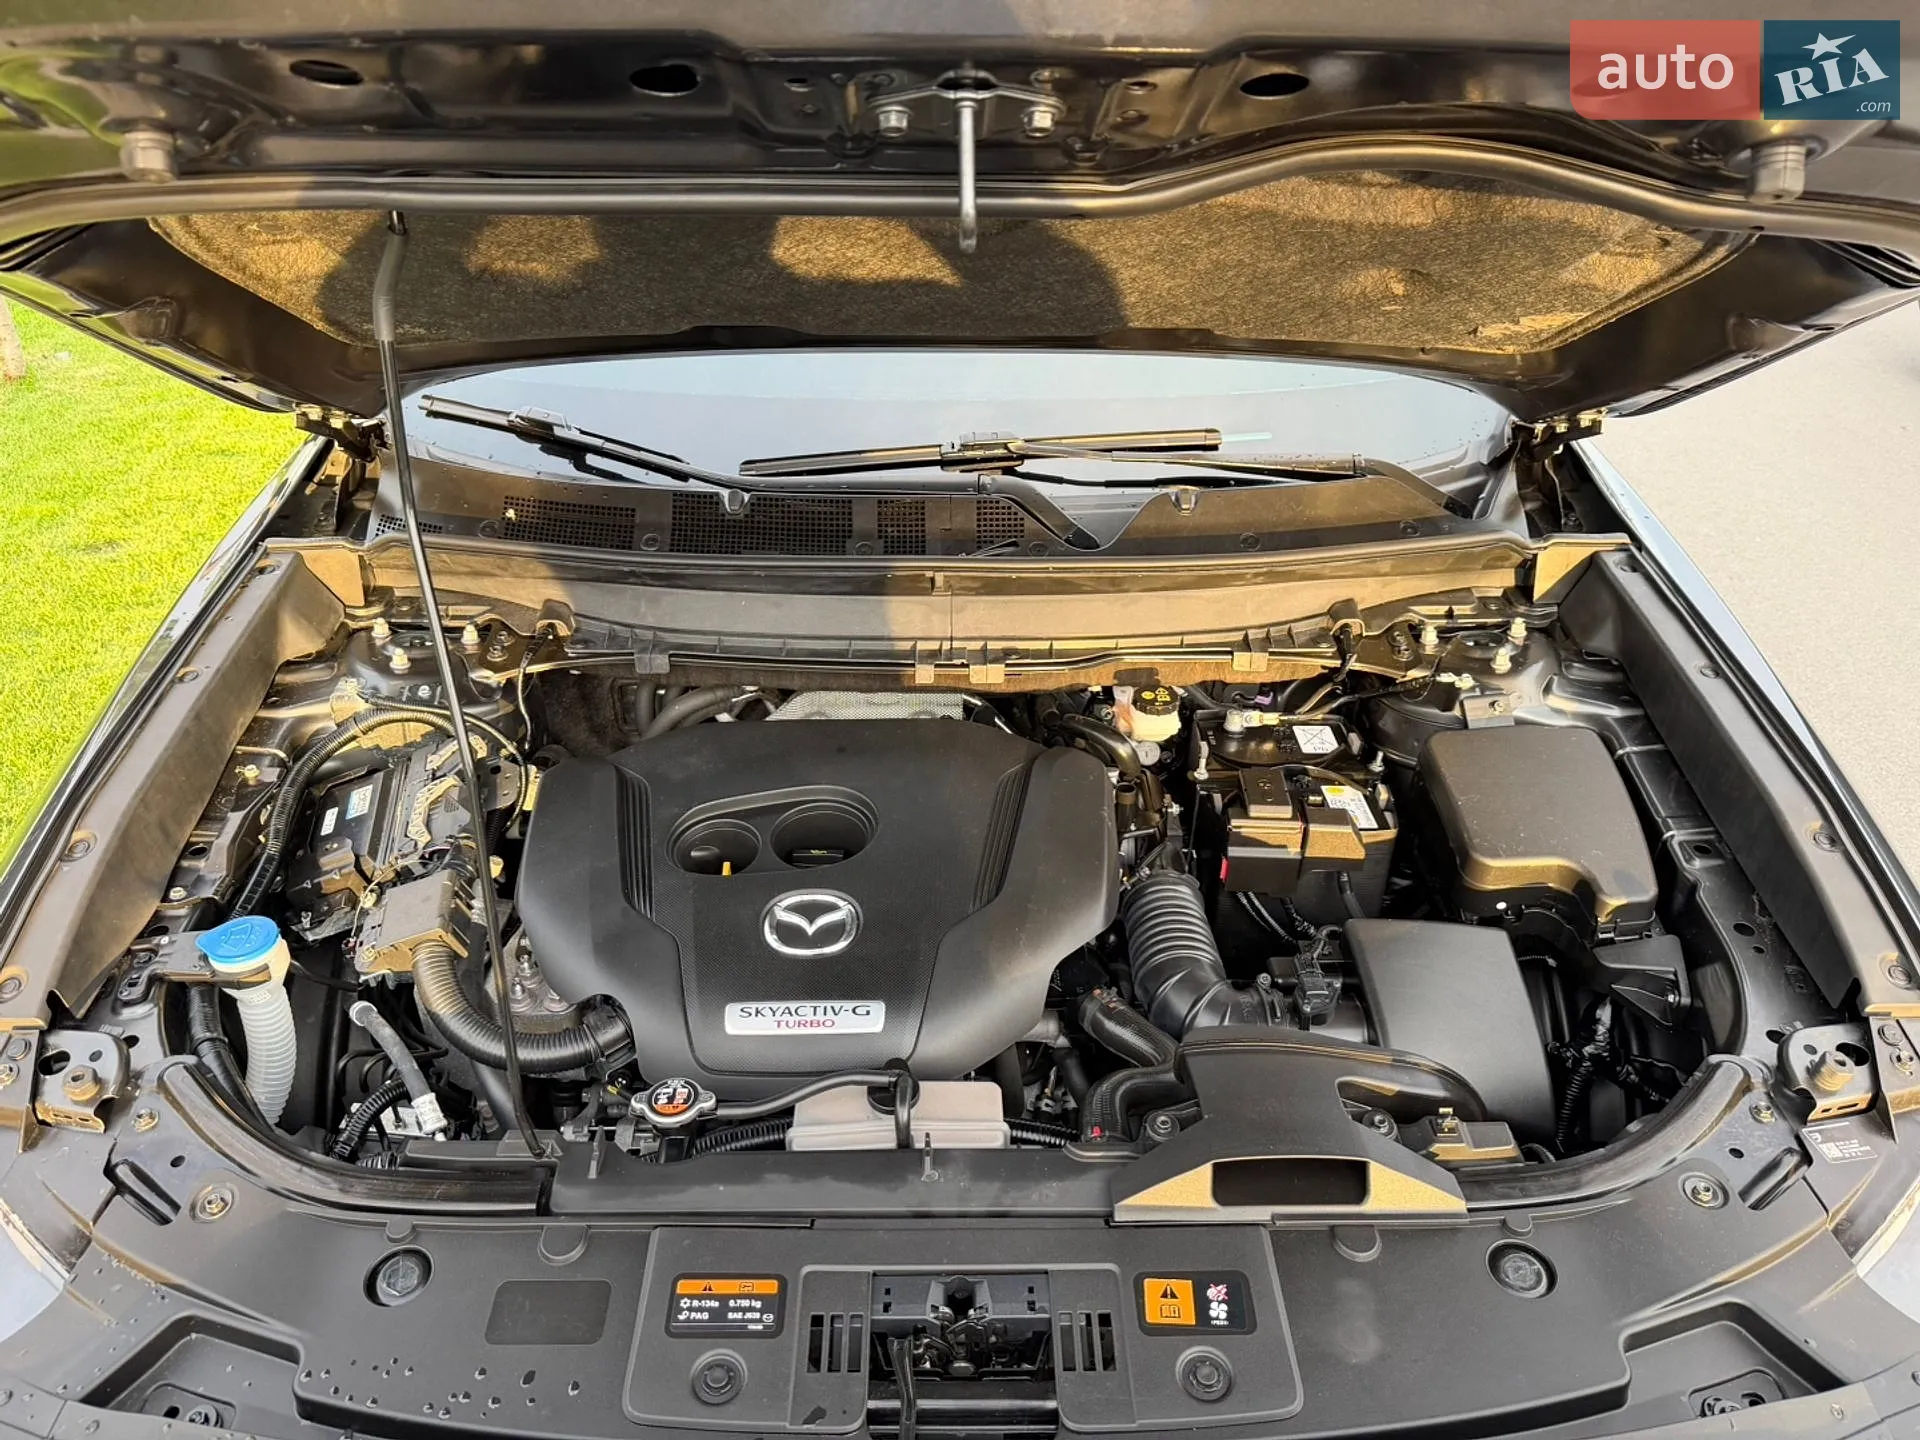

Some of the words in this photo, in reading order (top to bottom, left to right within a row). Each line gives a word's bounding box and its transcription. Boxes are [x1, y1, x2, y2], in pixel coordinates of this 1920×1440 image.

[739, 1005, 871, 1018] SKYACTIV-G
[773, 1018, 836, 1029] TURBO
[690, 1312, 709, 1320] PAG
